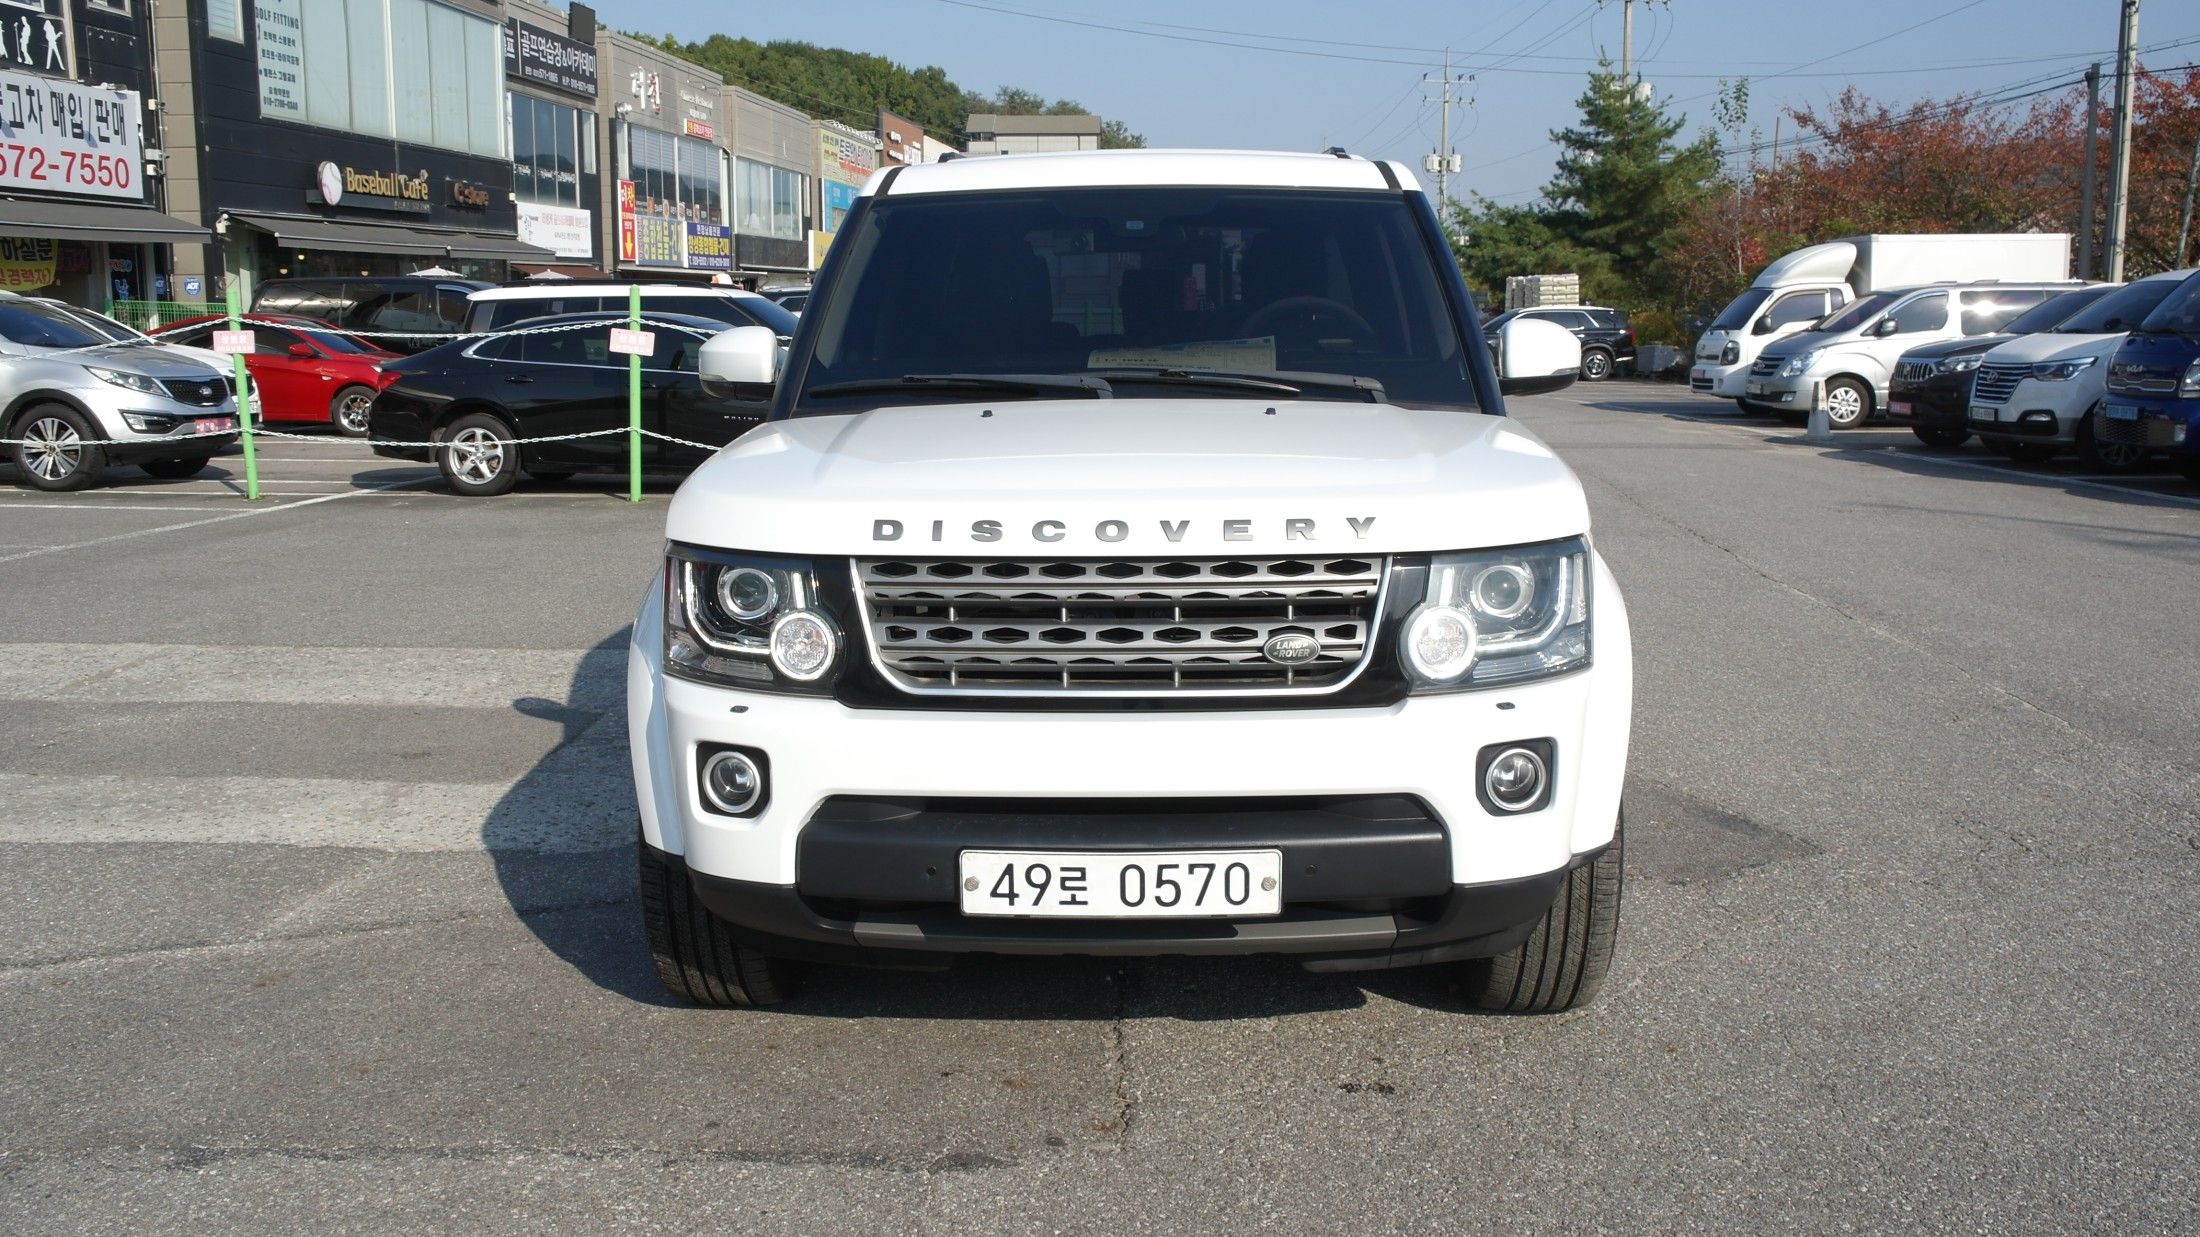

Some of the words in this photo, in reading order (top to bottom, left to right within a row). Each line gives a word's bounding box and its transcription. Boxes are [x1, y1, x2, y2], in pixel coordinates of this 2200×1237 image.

[520, 29, 597, 79] 골프연습장&아카데미
[50, 90, 127, 146] 매입/판매
[345, 167, 398, 197] Baseball
[186, 282, 200, 290] ADT
[872, 516, 1377, 542] DISCOVERY
[1276, 640, 1304, 650] LAND
[1278, 648, 1310, 658] ROVER
[990, 862, 1089, 907] 49로
[1119, 861, 1251, 908] 0570
